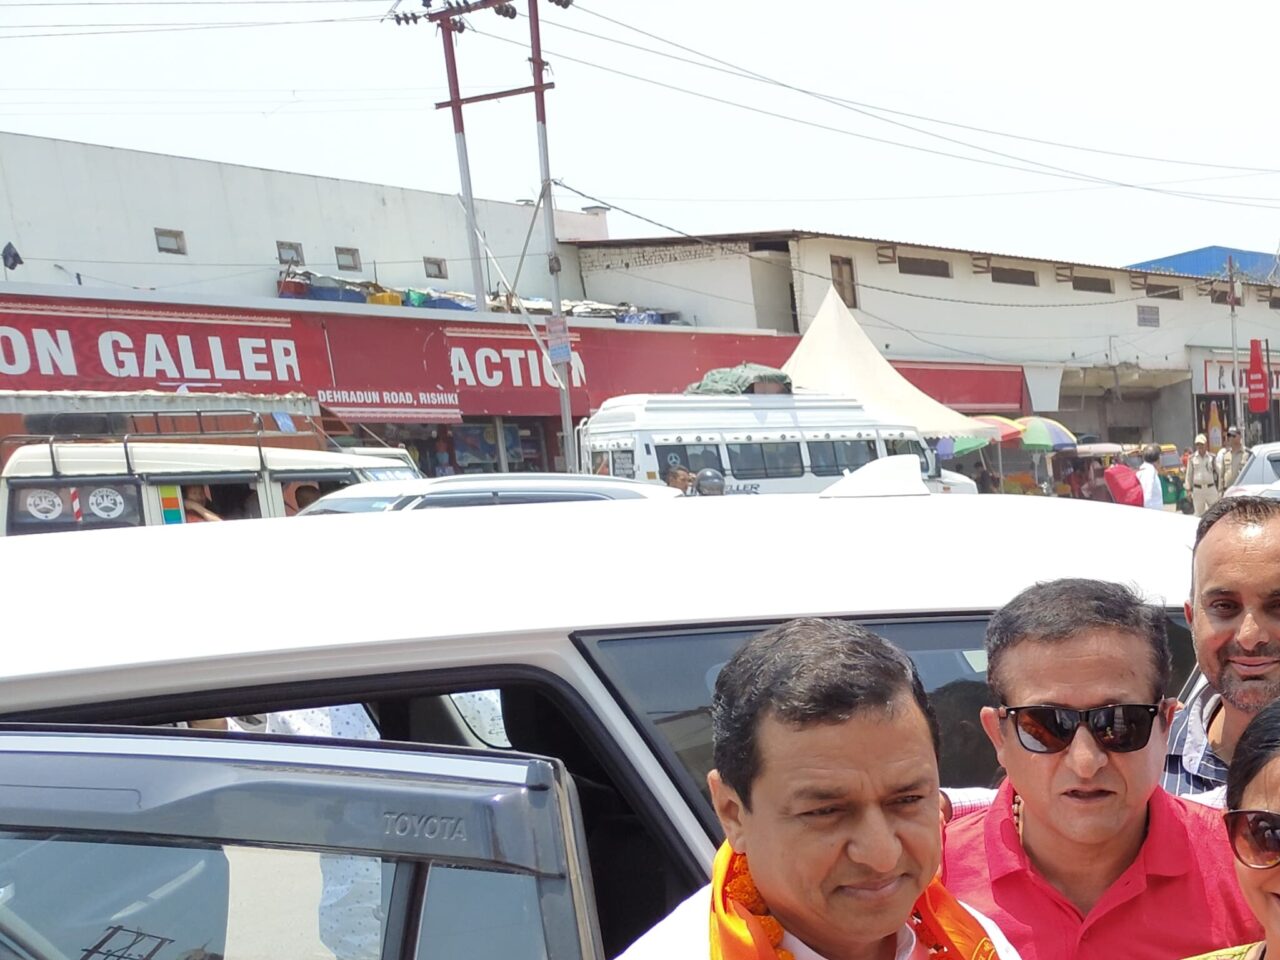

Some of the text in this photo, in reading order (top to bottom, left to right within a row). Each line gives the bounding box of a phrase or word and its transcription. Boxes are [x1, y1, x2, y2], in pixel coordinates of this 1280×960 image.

[318, 389, 380, 404] DEHRADUN
[383, 391, 417, 407] ROAD,
[383, 811, 468, 842] TOYOTA
